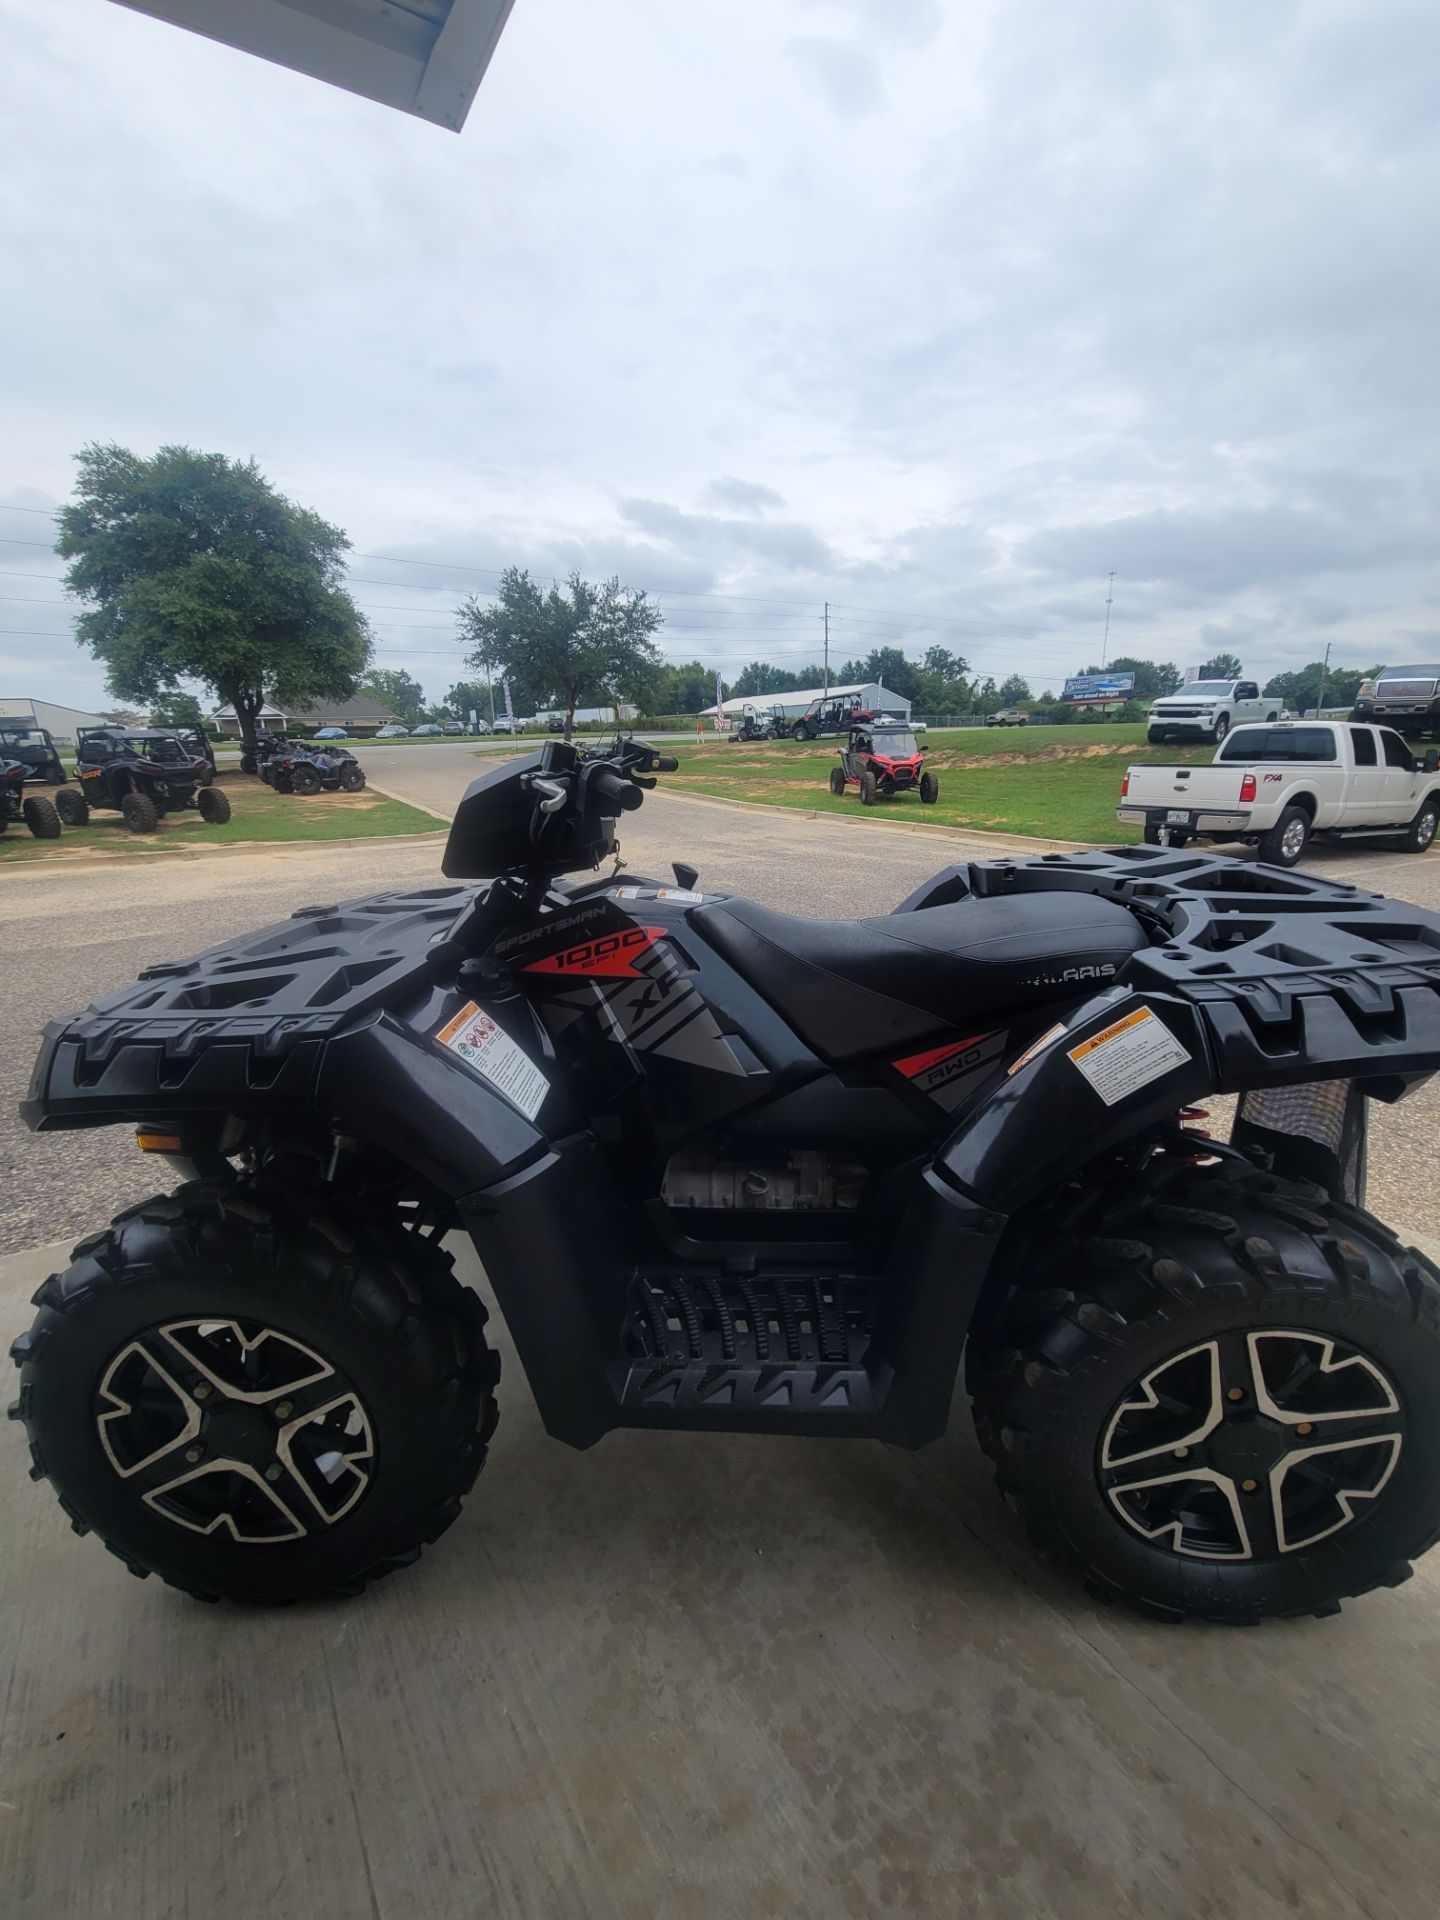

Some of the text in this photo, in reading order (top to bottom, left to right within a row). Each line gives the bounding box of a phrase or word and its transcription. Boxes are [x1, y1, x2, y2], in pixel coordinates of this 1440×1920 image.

[1263, 773, 1283, 782] FX4
[495, 905, 606, 952] SPORTSMAN
[555, 928, 649, 969] 1000
[581, 953, 616, 969] EFI
[1016, 963, 1117, 986] ARIS
[625, 968, 681, 1026] XP
[1096, 1020, 1132, 1043] WARNING
[927, 1049, 982, 1084] AWD
